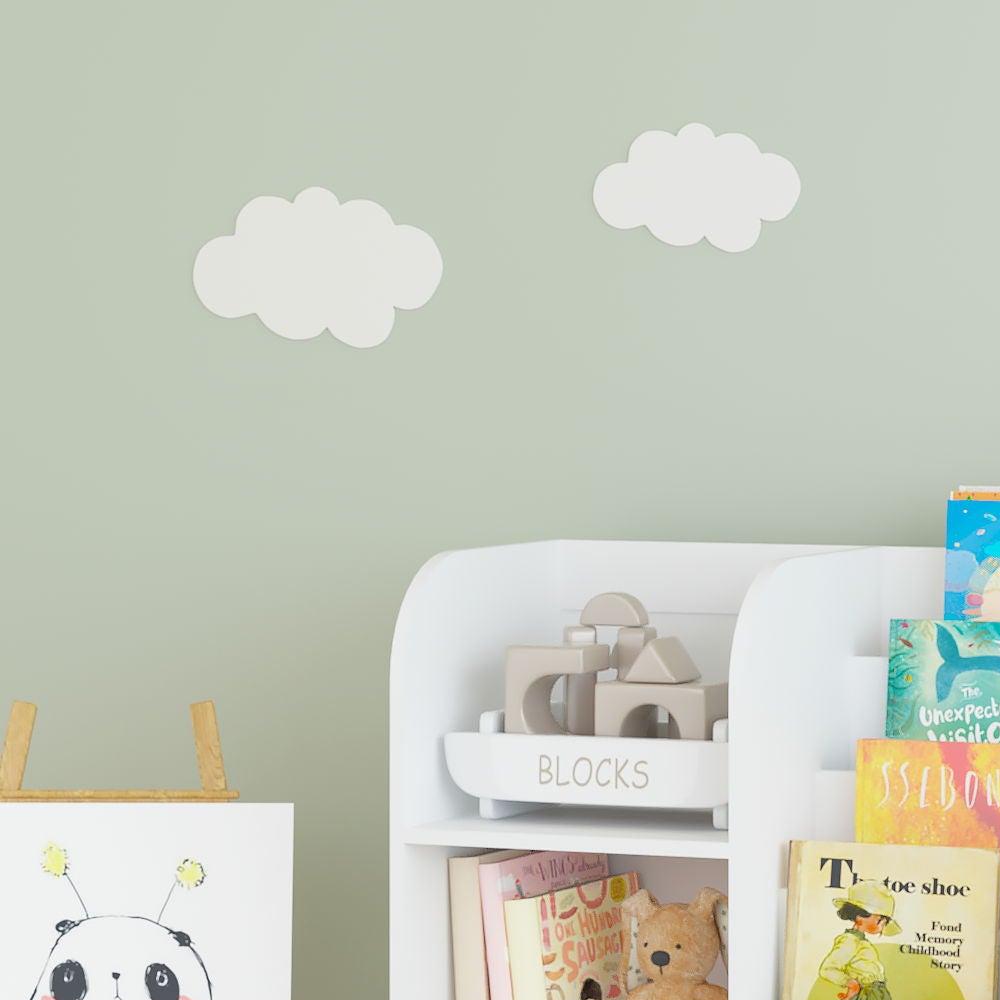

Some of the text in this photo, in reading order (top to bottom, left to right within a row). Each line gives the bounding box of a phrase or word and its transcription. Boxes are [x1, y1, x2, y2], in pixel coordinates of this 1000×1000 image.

[538, 754, 650, 790] BLOCKS
[920, 877, 971, 898] shoe
[931, 920, 962, 932] Fond
[914, 931, 963, 947] Memory
[899, 944, 960, 958] Childhood
[930, 959, 963, 974] Story
